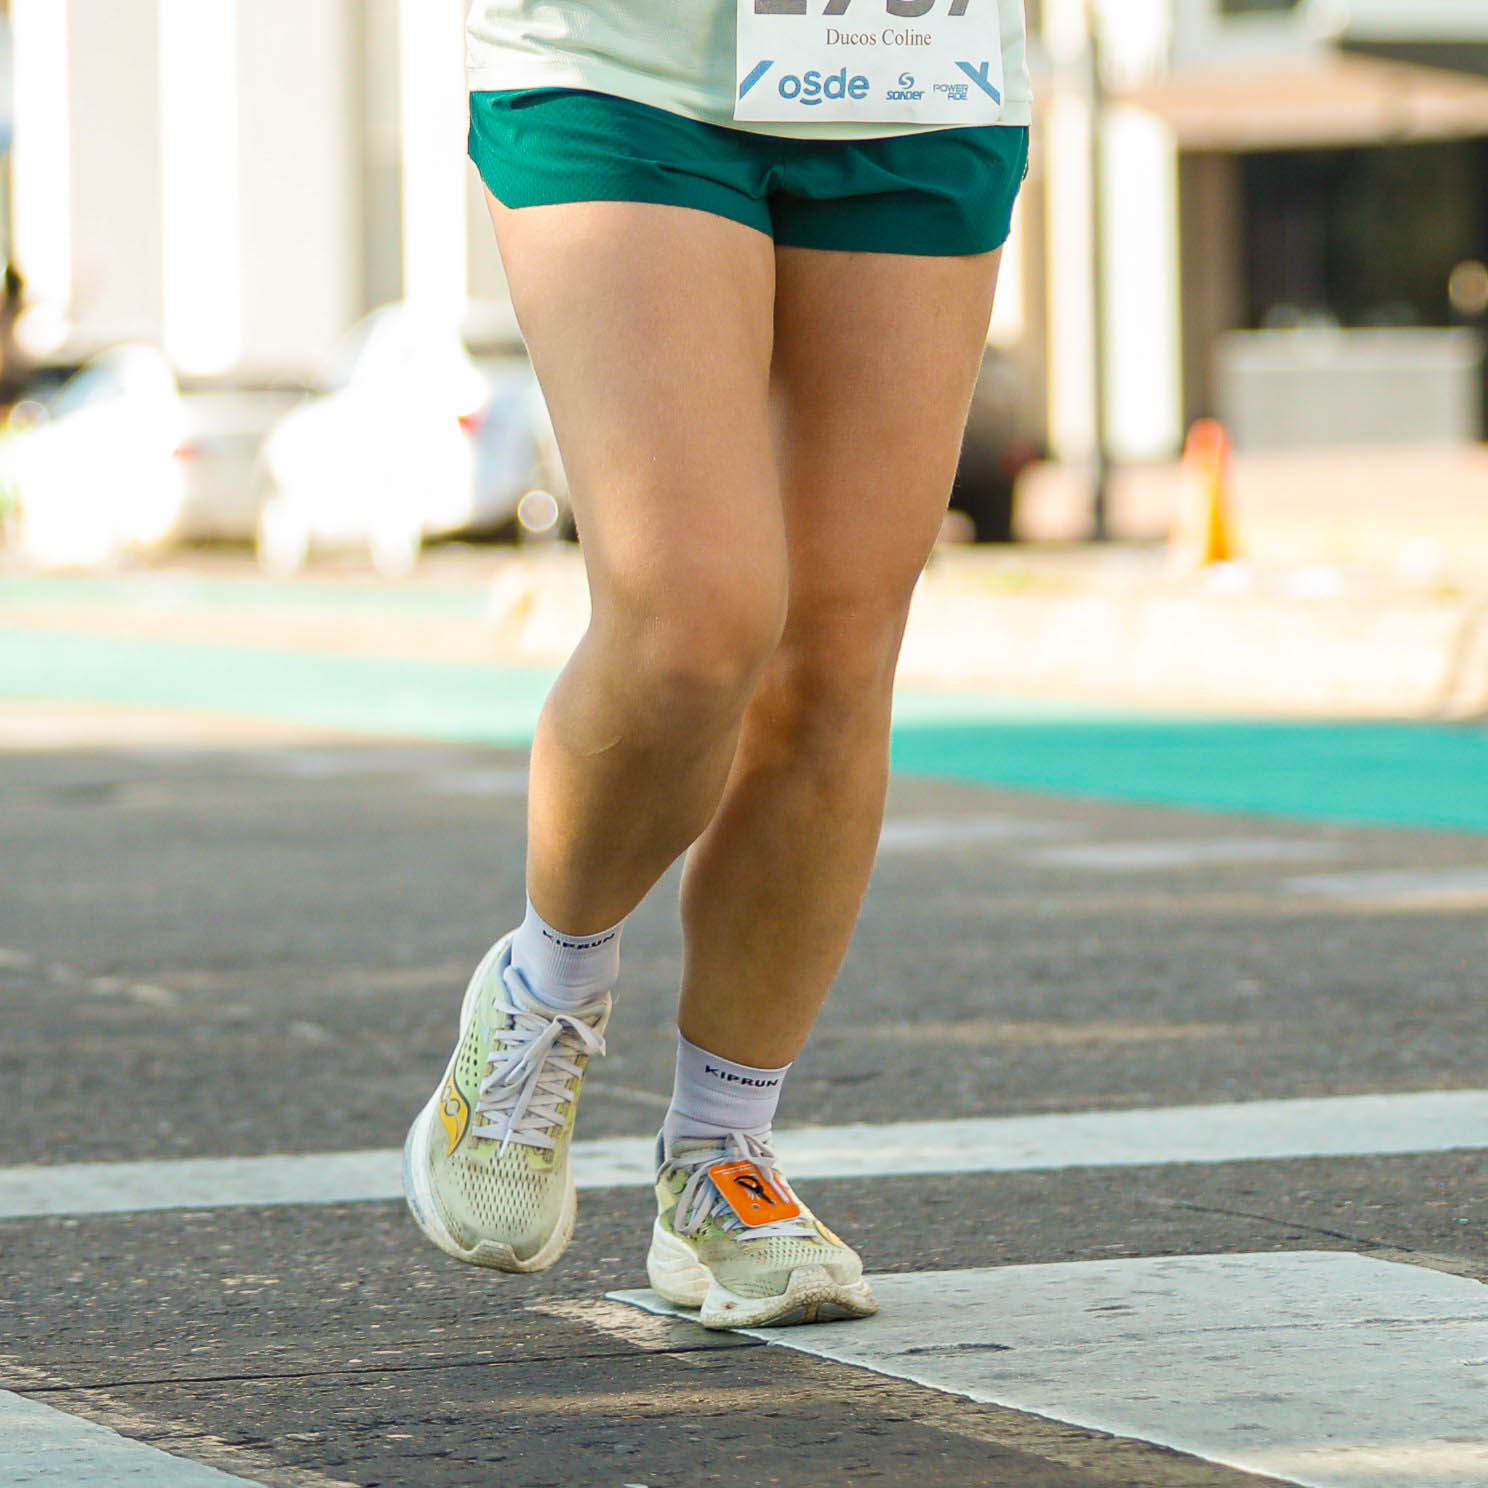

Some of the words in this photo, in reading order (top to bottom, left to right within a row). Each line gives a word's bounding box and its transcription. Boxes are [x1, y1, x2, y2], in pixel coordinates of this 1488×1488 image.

[825, 28, 877, 46] Ducos
[881, 28, 932, 46] Coline
[778, 67, 870, 100] osde
[704, 1064, 779, 1088] KIPRUN
